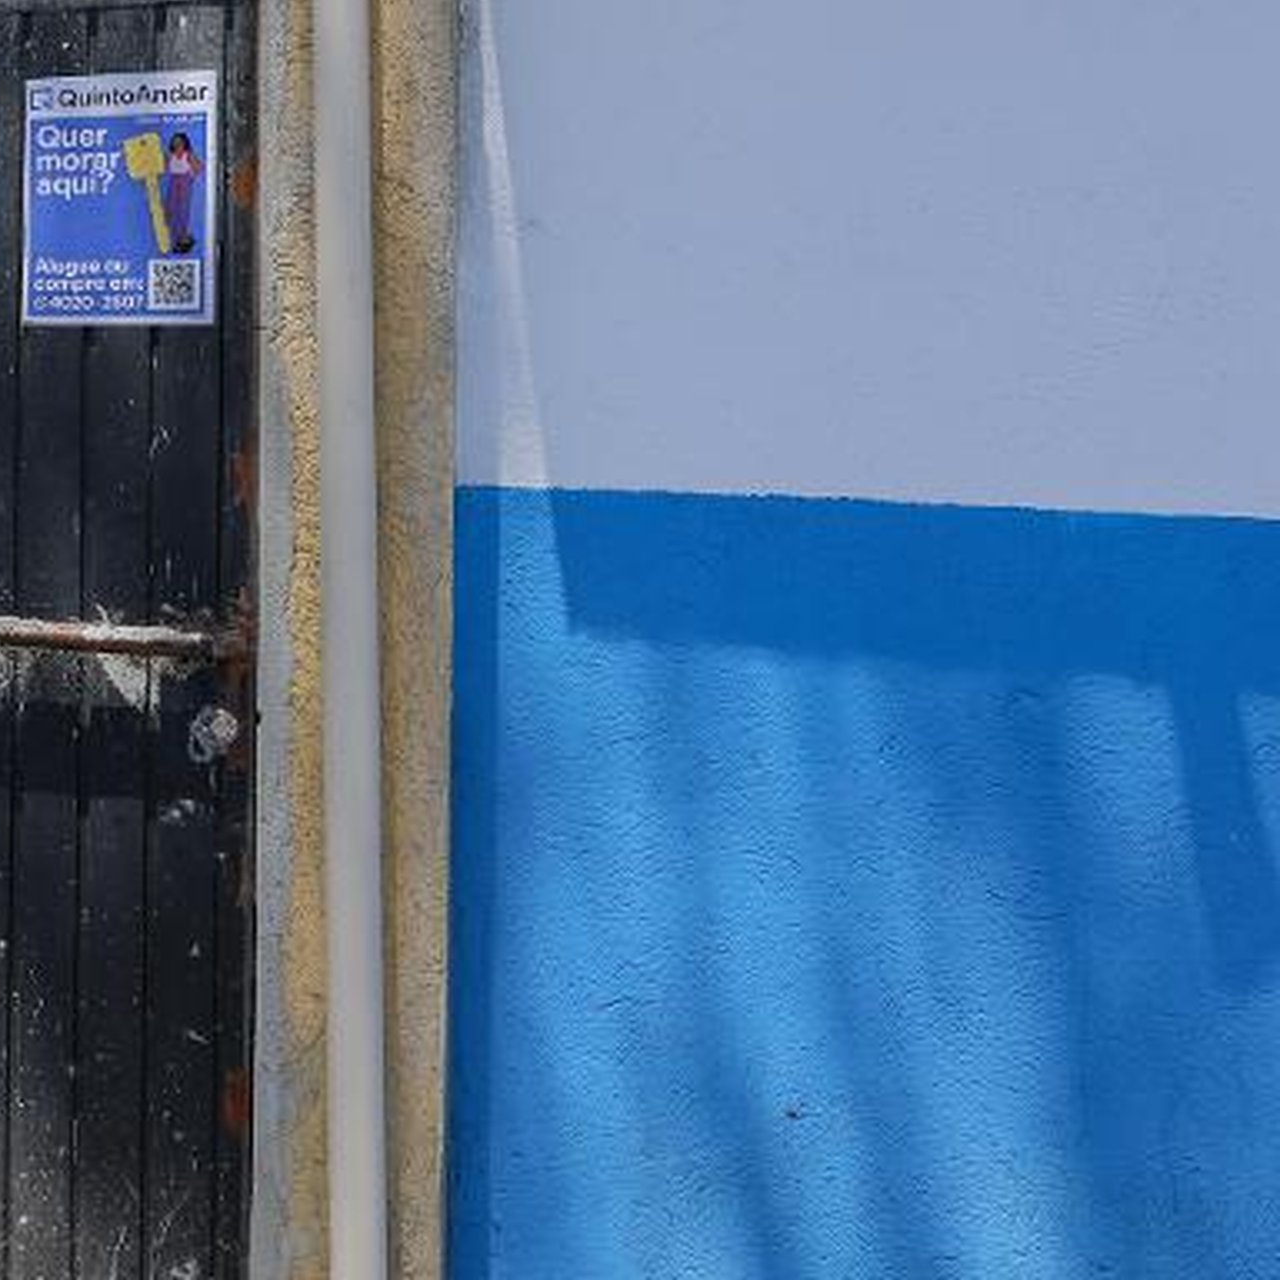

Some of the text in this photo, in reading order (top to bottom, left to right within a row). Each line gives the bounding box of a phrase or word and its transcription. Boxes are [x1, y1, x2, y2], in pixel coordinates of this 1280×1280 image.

[58, 83, 208, 108] QuintoAndar
[37, 125, 108, 149] Quer
[36, 151, 121, 171] morar
[36, 170, 116, 201] aqui?
